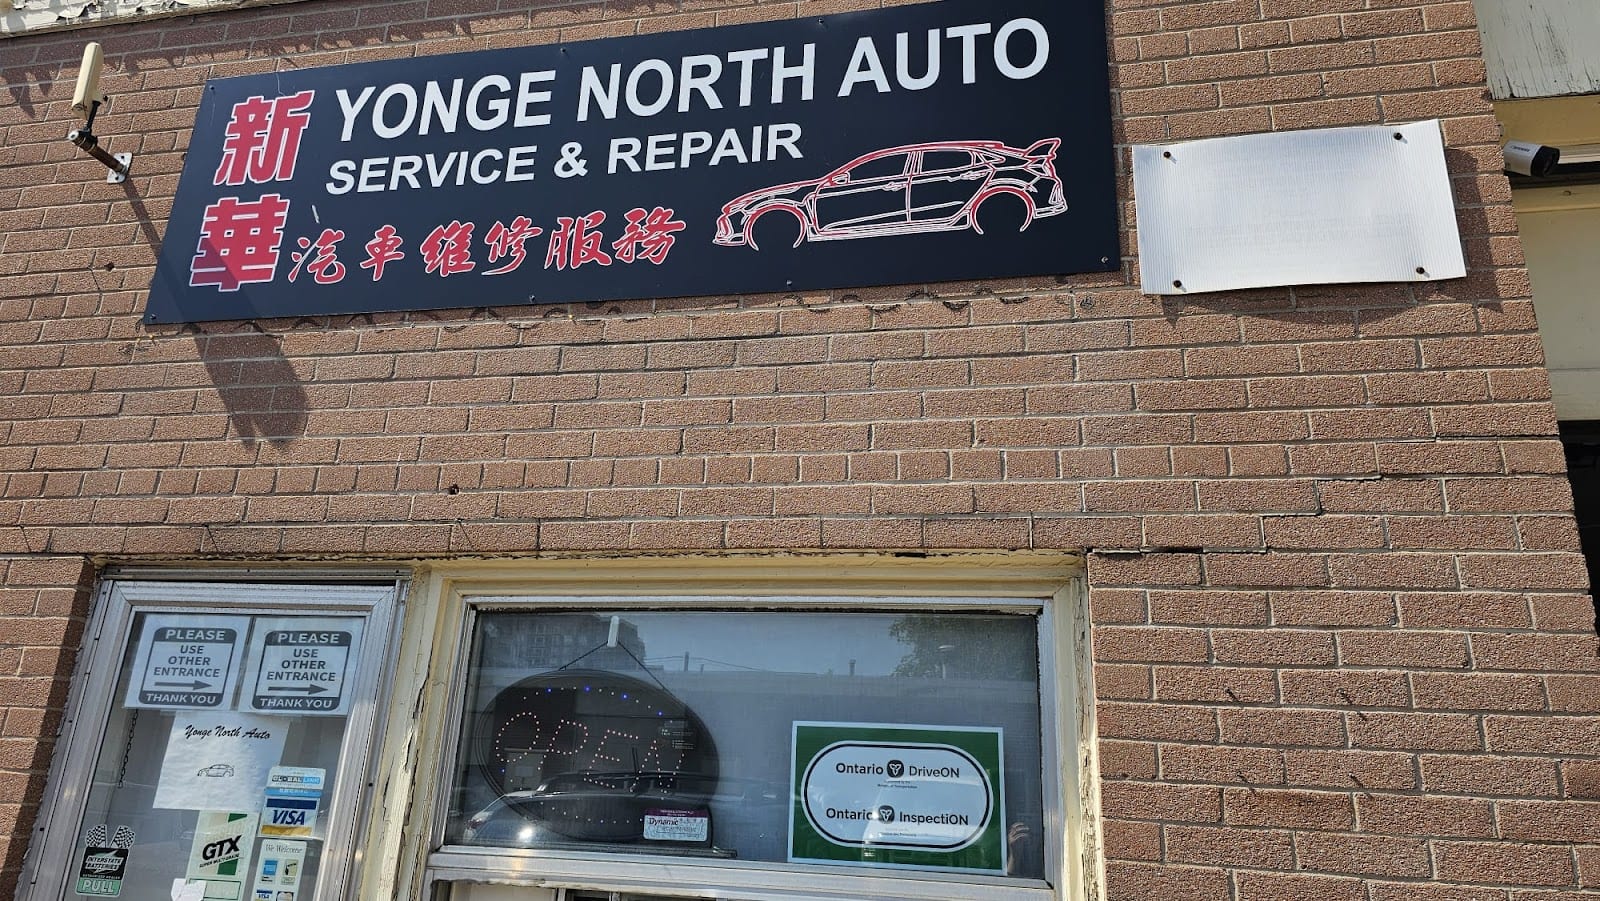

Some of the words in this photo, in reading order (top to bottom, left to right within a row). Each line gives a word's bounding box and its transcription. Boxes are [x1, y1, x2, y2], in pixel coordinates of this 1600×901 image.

[335, 70, 557, 142] YONGE
[577, 43, 816, 121] NORTH
[837, 17, 1050, 97] AUTO
[326, 145, 537, 195] SERVICE
[554, 142, 587, 178] &
[607, 123, 803, 174] REPAIR
[189, 90, 315, 291] 新華
[288, 205, 687, 285] 汽車維修服務
[165, 629, 225, 641] PLEASE
[277, 632, 340, 644] PLEASE
[180, 645, 204, 655] USE
[293, 648, 318, 658] USE
[168, 656, 210, 666] OTHER
[281, 660, 326, 670] OTHER
[153, 666, 220, 678] ENTRANCE
[266, 671, 336, 682] ENTRANCE
[145, 693, 187, 704] THANK
[190, 693, 217, 705] YOU
[259, 697, 303, 709] THANK
[305, 698, 332, 709] YOU
[185, 724, 212, 740] Yonge
[214, 725, 242, 738] North
[242, 727, 271, 740] Auto
[496, 712, 684, 800] OPEN
[836, 763, 884, 774] Ontario
[909, 766, 960, 778] DriveON
[272, 809, 305, 825] VISA
[900, 811, 969, 826] InspectiON
[202, 835, 242, 861] GTX
[82, 880, 114, 892] PULL
